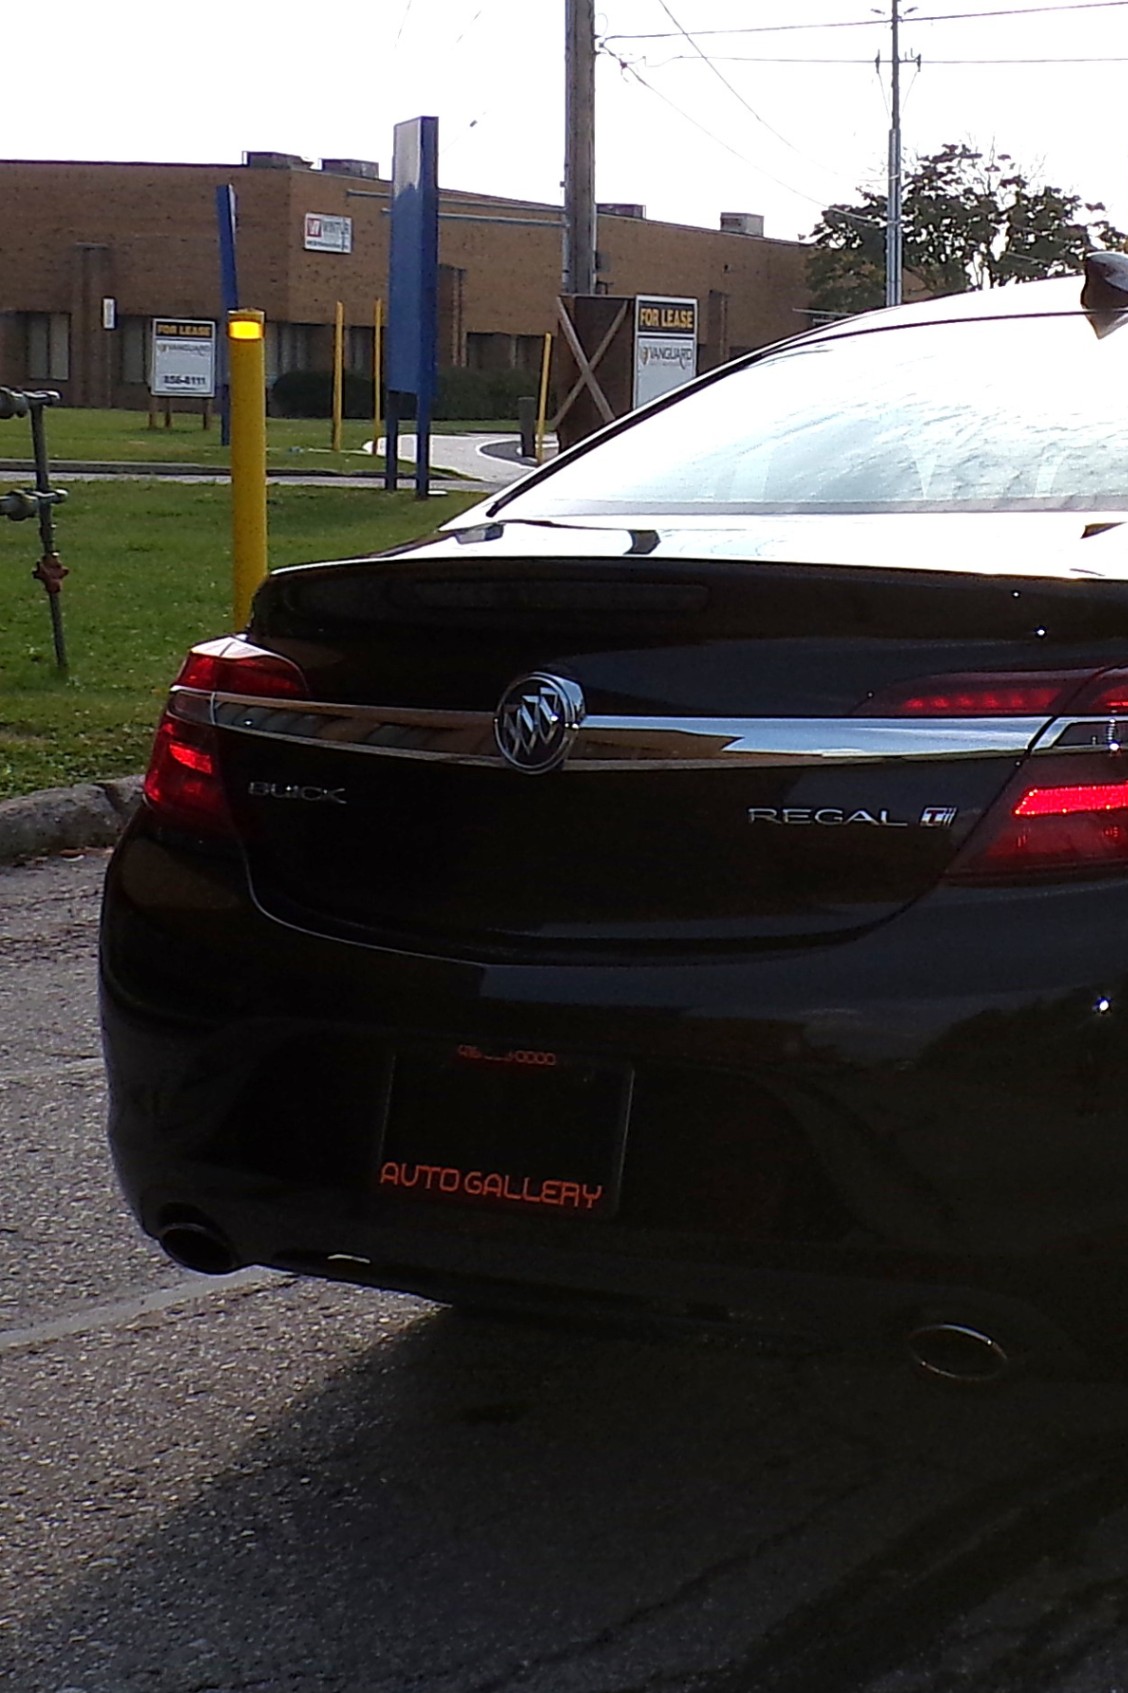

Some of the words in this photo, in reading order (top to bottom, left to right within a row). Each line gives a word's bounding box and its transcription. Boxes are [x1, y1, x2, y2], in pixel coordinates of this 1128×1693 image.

[640, 307, 659, 328] FOR
[661, 308, 694, 329] LEASE
[157, 324, 178, 335] FOR
[179, 325, 211, 336] LEASE
[649, 346, 693, 370] VANGUARD
[248, 782, 347, 804] BUICK
[748, 808, 908, 827] REGAL
[380, 1161, 460, 1193] AUTO
[464, 1170, 602, 1209] GALLERY
